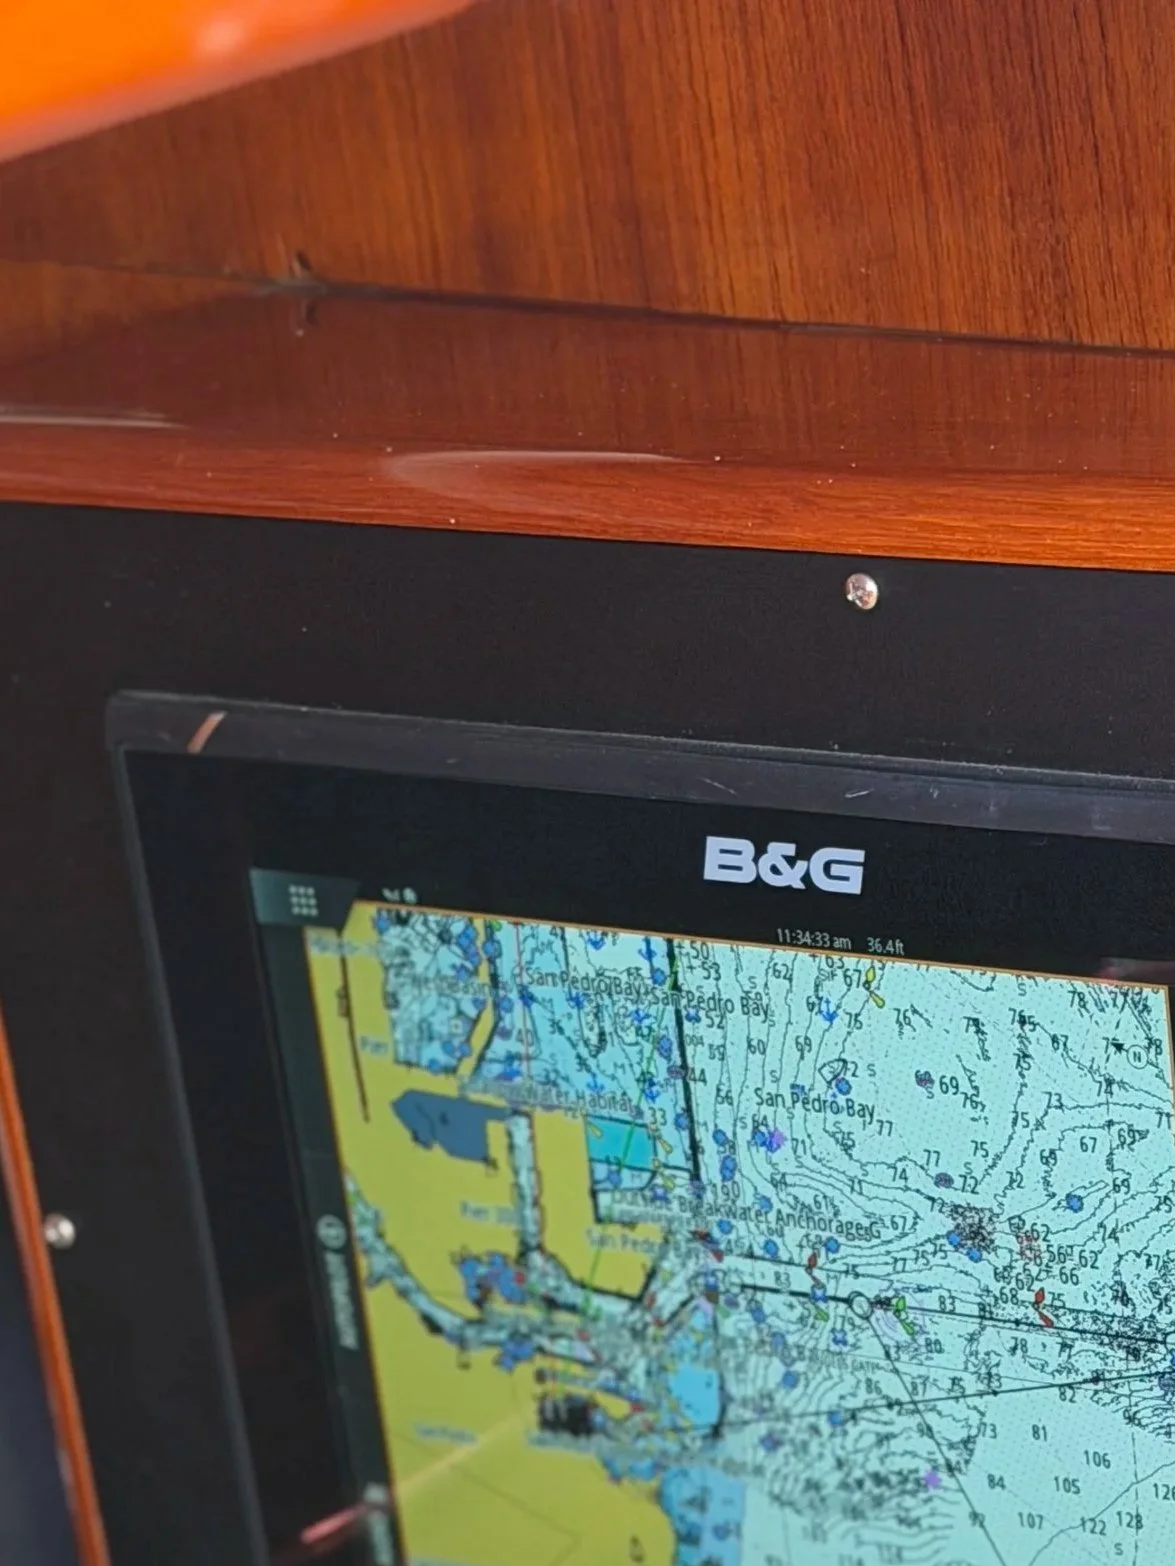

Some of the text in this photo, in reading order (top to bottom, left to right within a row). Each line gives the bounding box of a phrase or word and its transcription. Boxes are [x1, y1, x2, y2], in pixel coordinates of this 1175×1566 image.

[703, 836, 865, 895] B&G
[777, 928, 851, 950] 11:34:33 am
[772, 963, 790, 980] 62
[683, 990, 736, 1015] Pedro
[740, 997, 770, 1024] Bay
[939, 1075, 960, 1095] 69
[754, 1087, 876, 1126] San Pedro Bay
[876, 1120, 894, 1137] 77
[971, 1140, 990, 1158] 75
[1080, 1136, 1098, 1153] 67
[923, 1149, 941, 1167] 77
[890, 1167, 908, 1184] 74
[1112, 1176, 1132, 1195] 69
[1030, 1223, 1050, 1242] 62
[1079, 1249, 1099, 1269] 62
[1059, 1265, 1080, 1286] 66
[1000, 1286, 1019, 1305] 68
[1032, 1423, 1048, 1442] 81
[1083, 1449, 1111, 1469] 106
[987, 1473, 1006, 1491] 84
[1053, 1476, 1081, 1495] 105
[1017, 1512, 1044, 1530] 107
[1080, 1516, 1107, 1537] 122
[1116, 1511, 1144, 1531] 128
